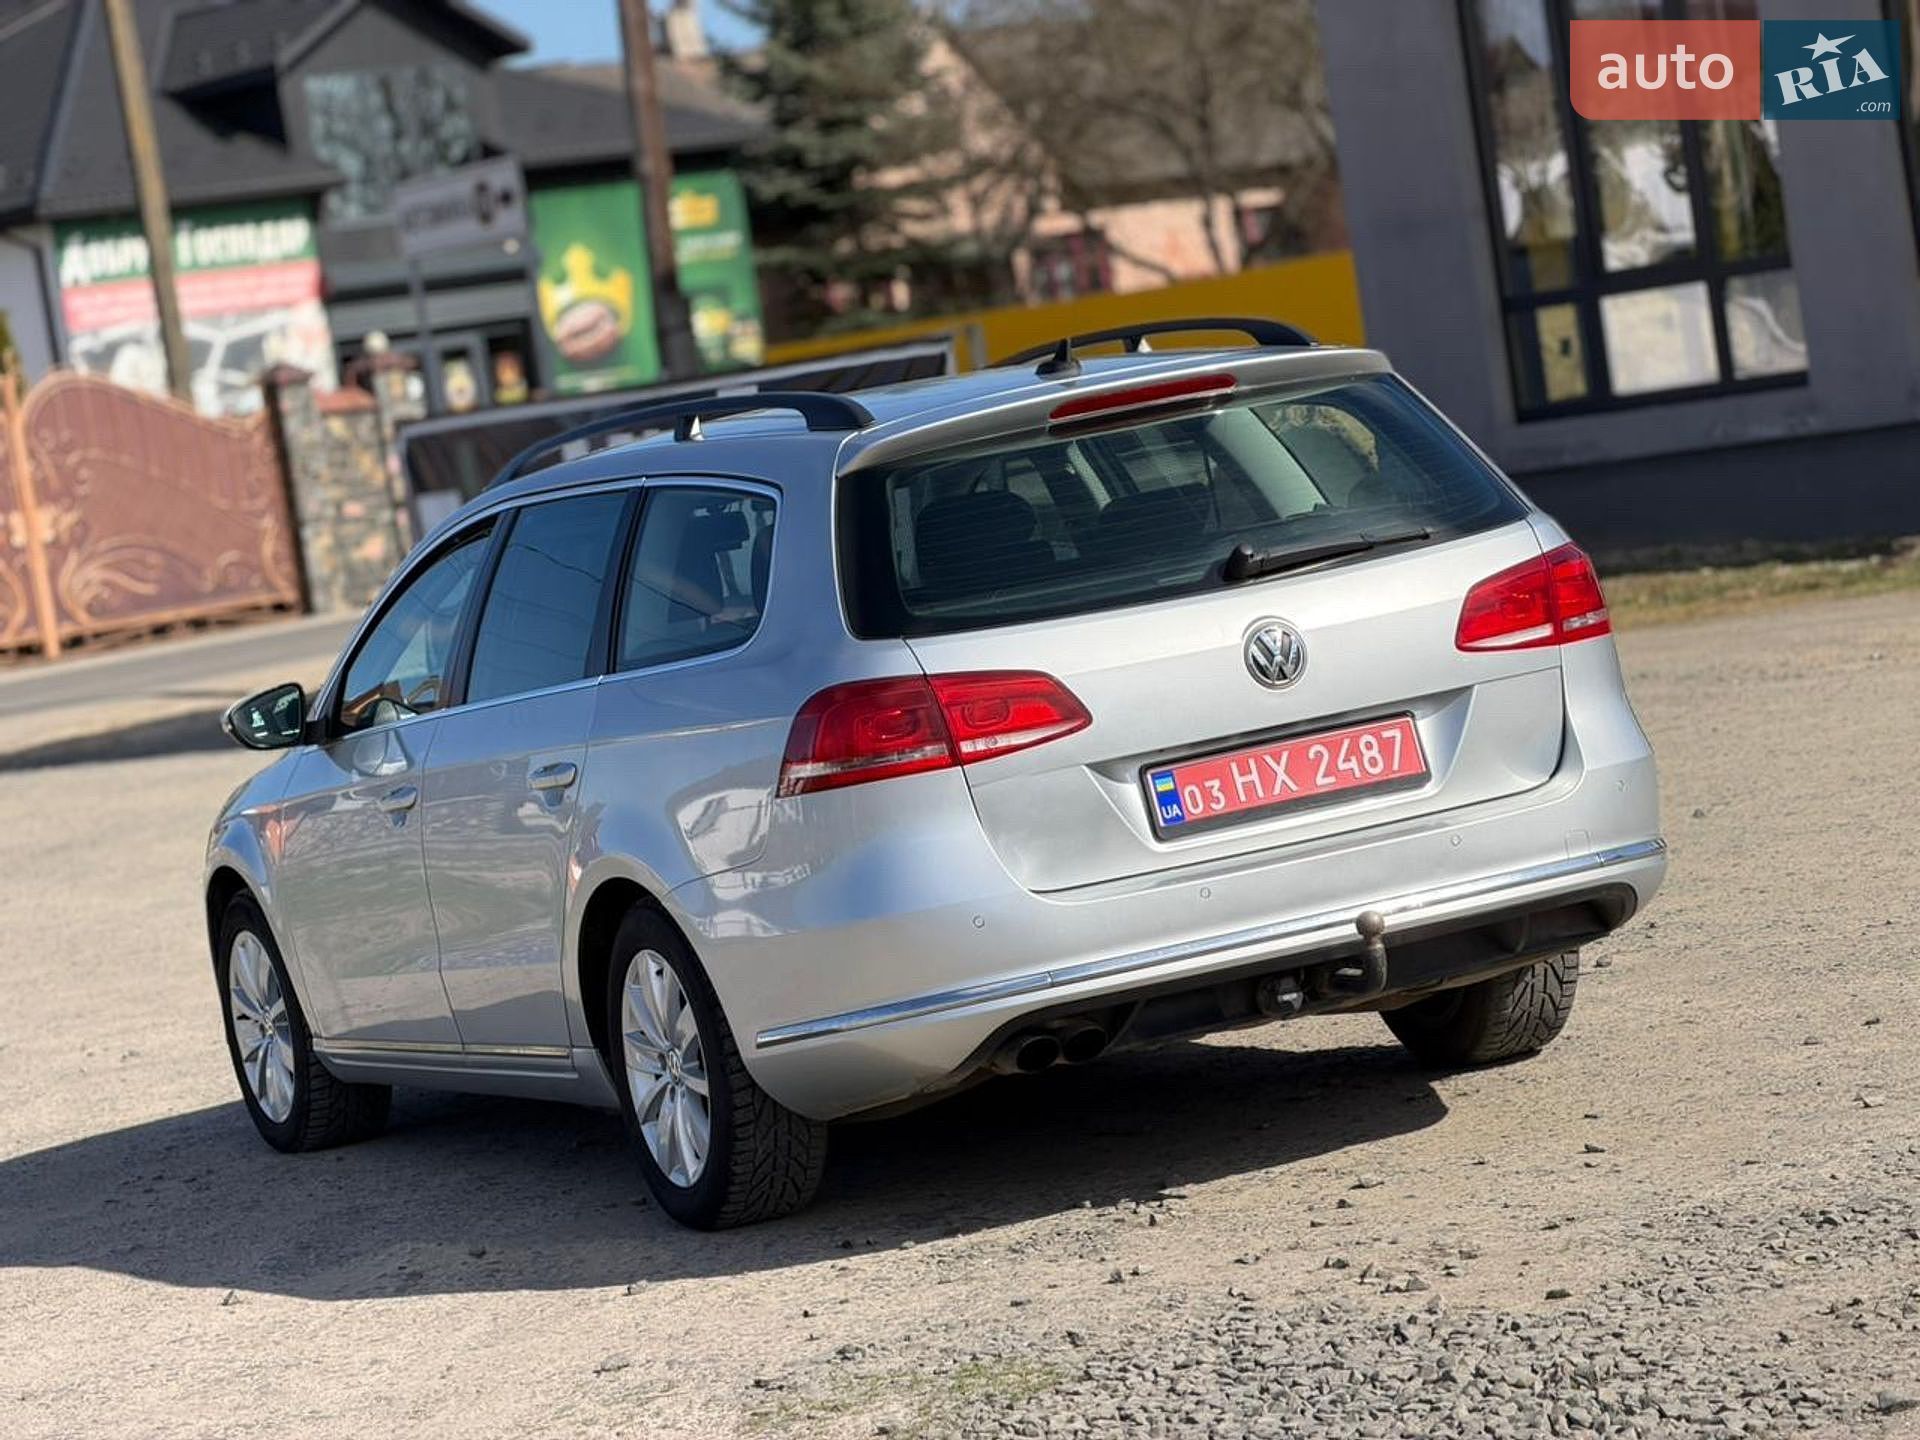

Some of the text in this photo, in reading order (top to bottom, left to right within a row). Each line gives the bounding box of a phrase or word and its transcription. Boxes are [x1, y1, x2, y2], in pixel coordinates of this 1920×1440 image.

[1183, 779, 1226, 816] 03
[1308, 728, 1402, 787] 2487
[1161, 803, 1183, 819] UA
